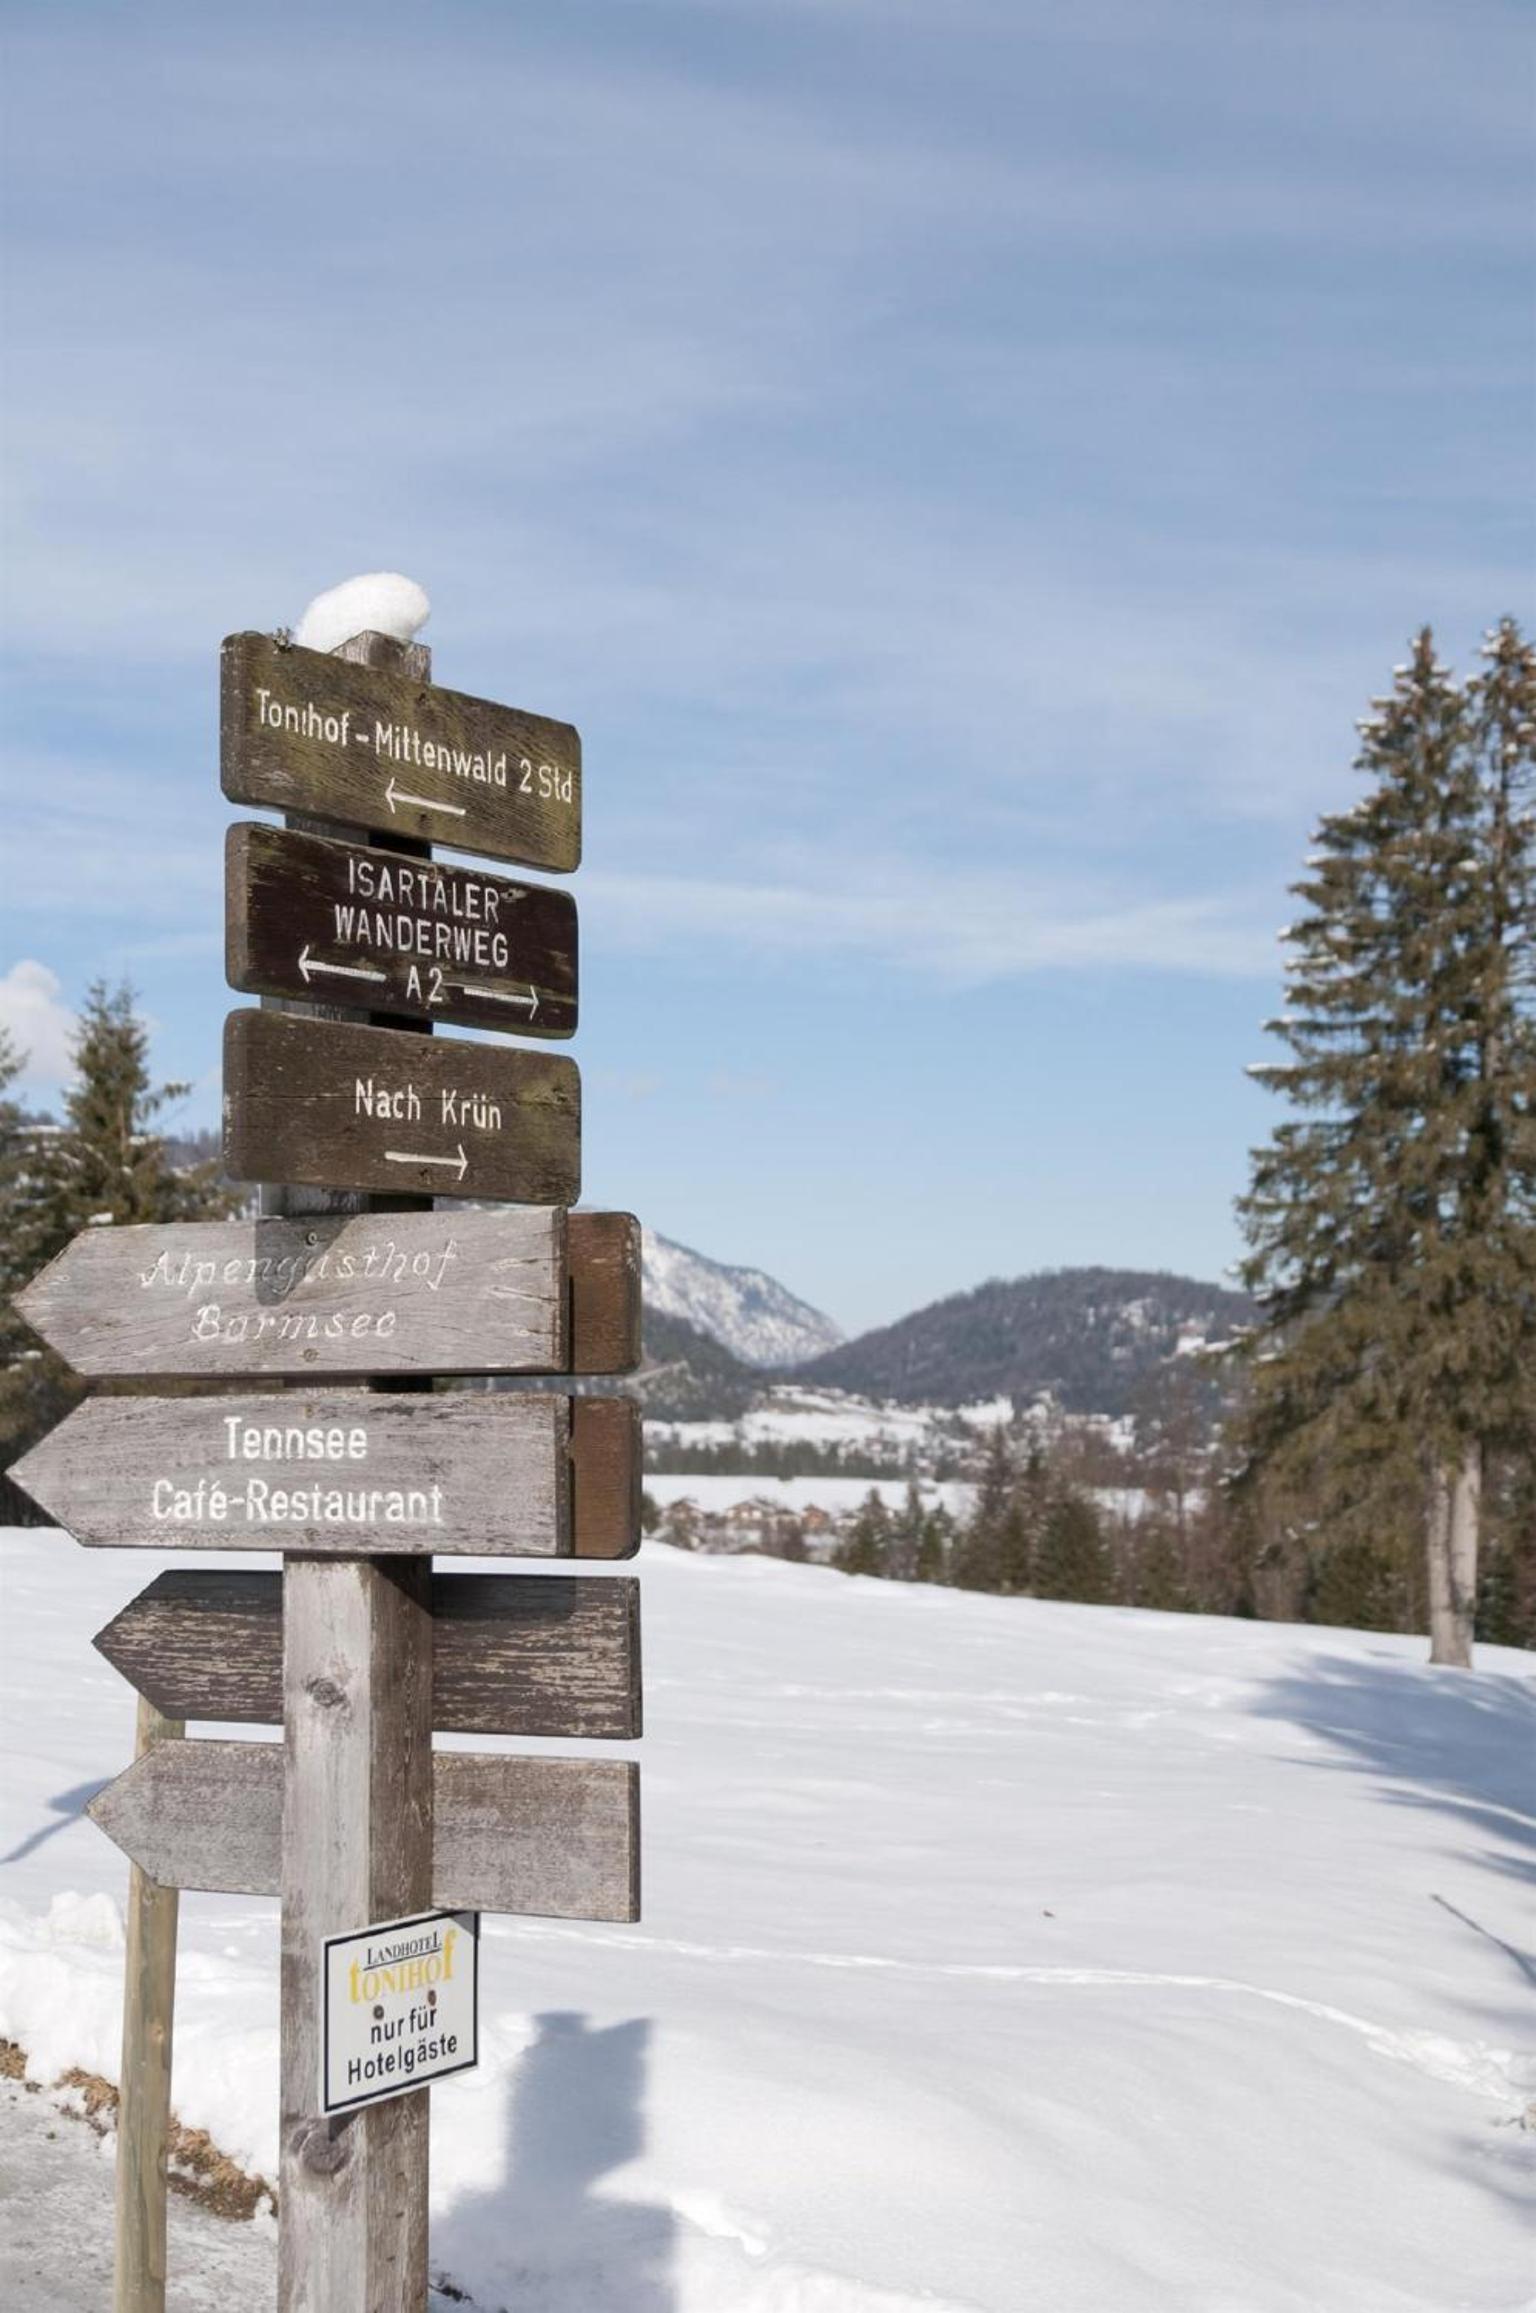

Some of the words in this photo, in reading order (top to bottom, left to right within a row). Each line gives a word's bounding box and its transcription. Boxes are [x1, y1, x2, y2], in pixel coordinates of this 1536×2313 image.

[375, 720, 507, 787] Mittenwald
[519, 758, 532, 794] 2
[539, 765, 573, 804] Std
[348, 857, 499, 923] ISARTALER
[334, 904, 508, 967] WANDERWEG
[355, 1078, 421, 1121] Nach
[442, 1088, 501, 1130] Krün
[138, 1239, 457, 1298] Alpengasthof
[191, 1303, 397, 1345] Barmsee
[223, 1415, 368, 1460] Tennsee
[152, 1478, 444, 1523] Café-Restaurant
[366, 1931, 442, 1966] LANDHOTEL
[371, 2018, 405, 2045] nur
[409, 2006, 438, 2033] für
[347, 2034, 458, 2086] Hotelgäste
